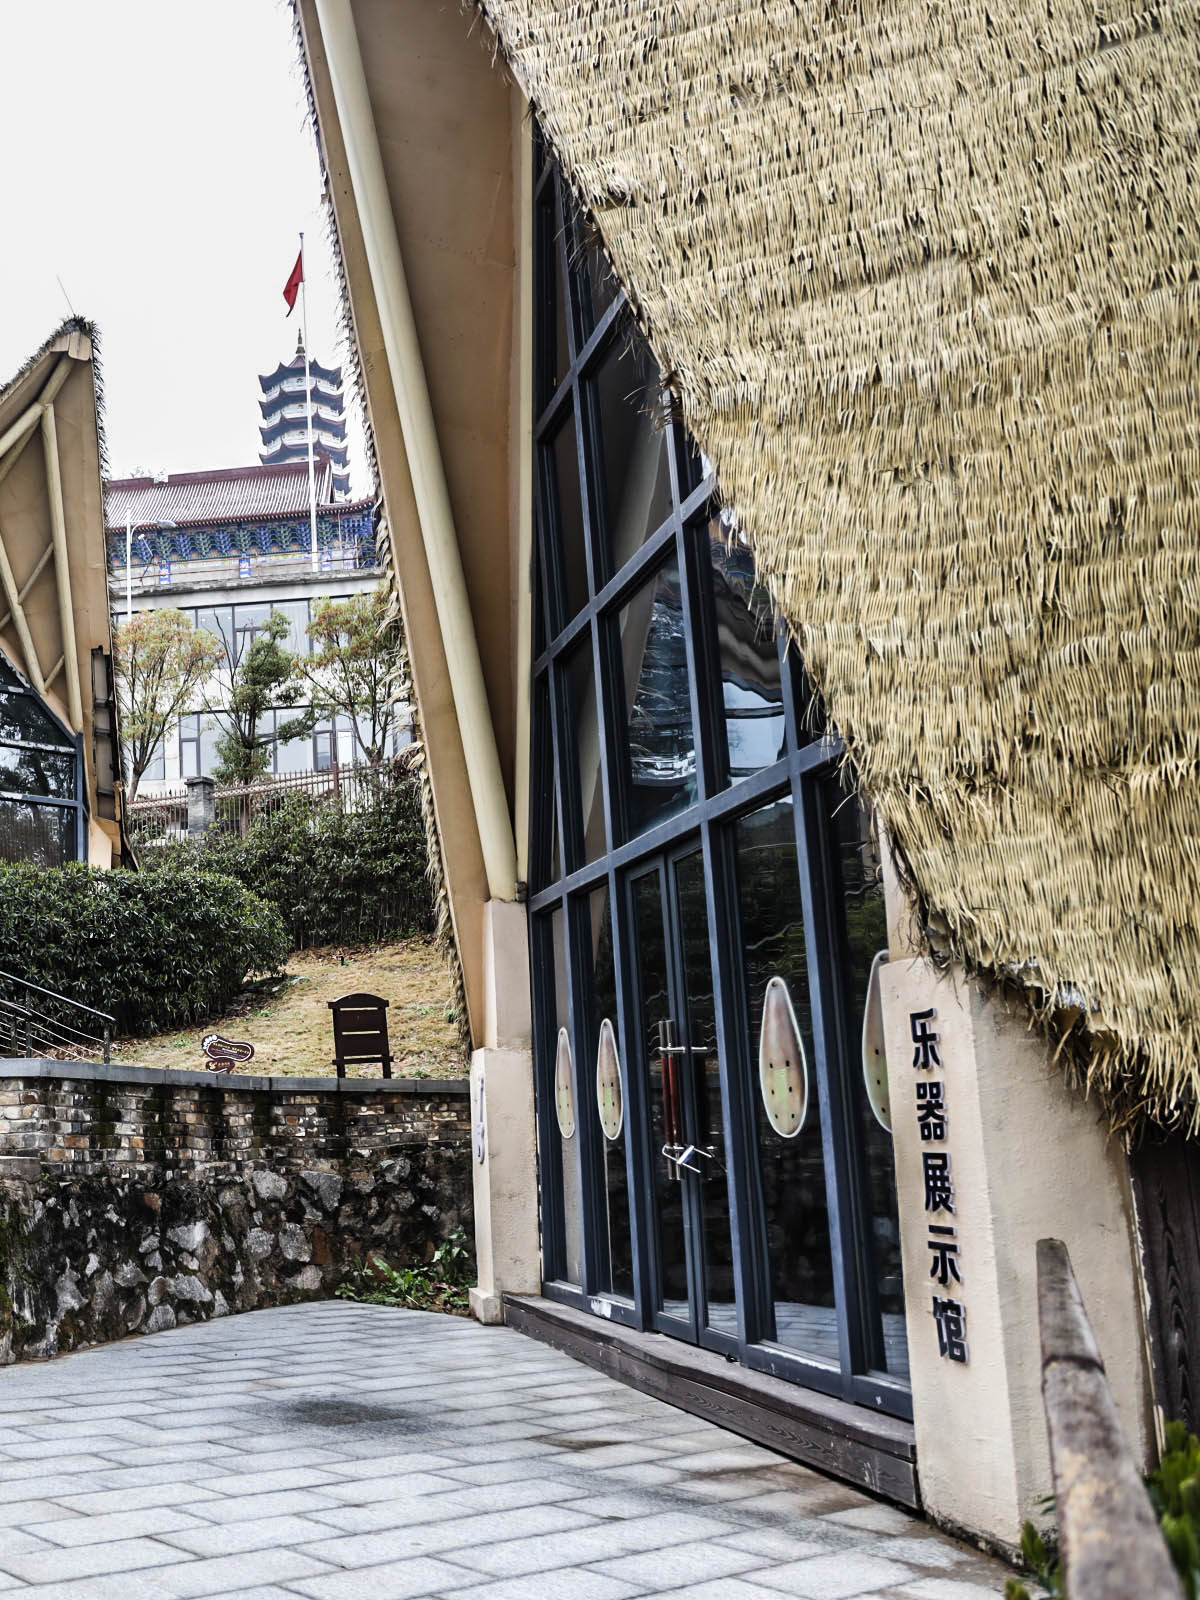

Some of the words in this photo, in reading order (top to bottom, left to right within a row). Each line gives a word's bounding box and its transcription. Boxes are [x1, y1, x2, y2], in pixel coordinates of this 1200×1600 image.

[909, 1007, 968, 1364] 乐器展示馆
